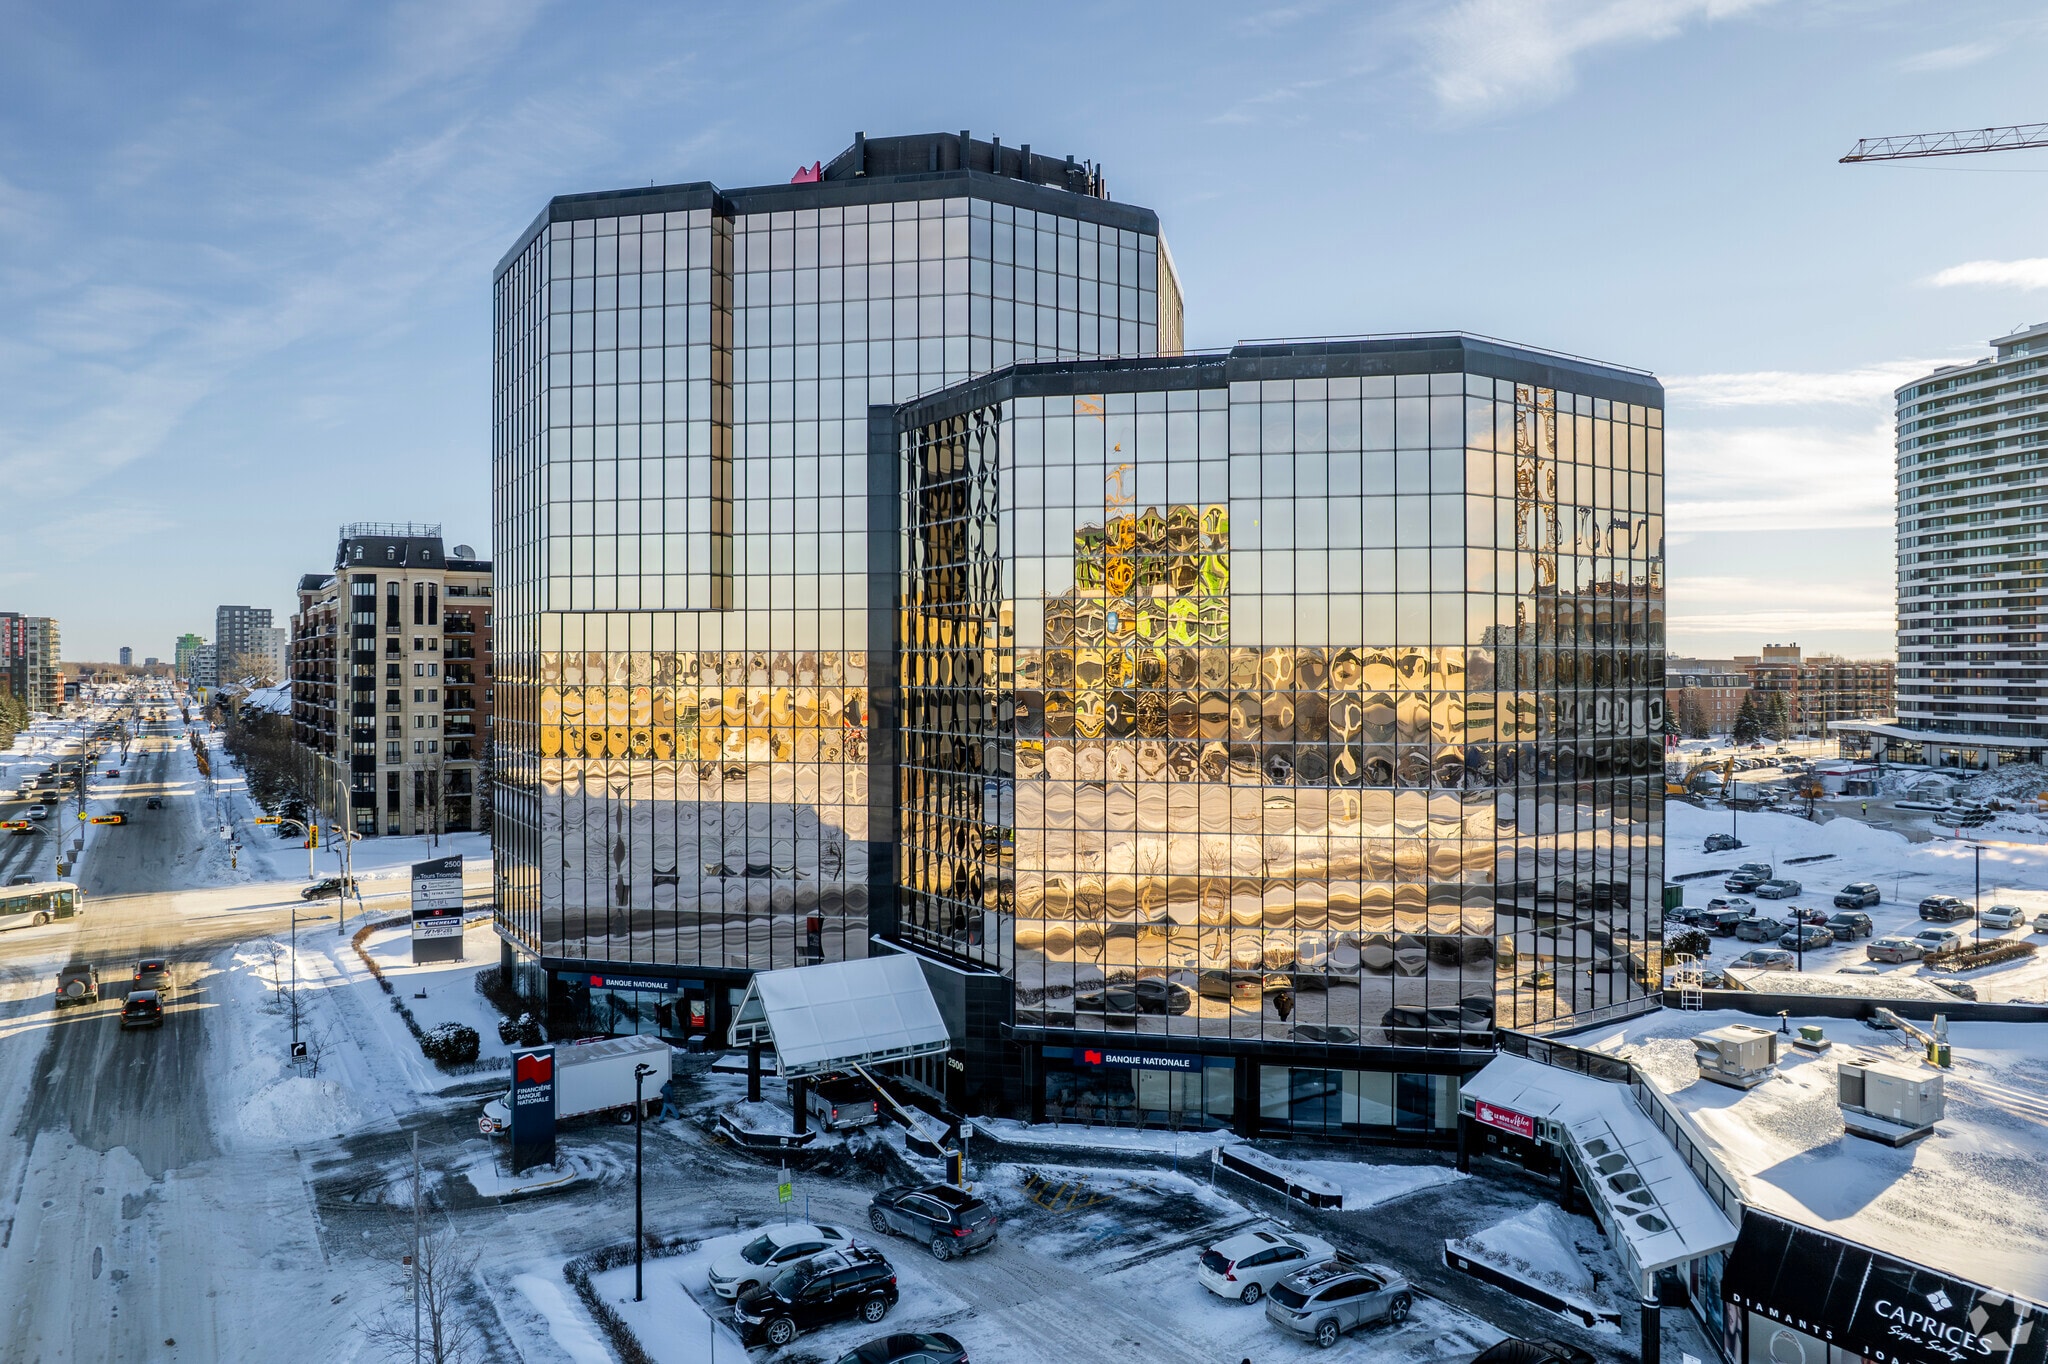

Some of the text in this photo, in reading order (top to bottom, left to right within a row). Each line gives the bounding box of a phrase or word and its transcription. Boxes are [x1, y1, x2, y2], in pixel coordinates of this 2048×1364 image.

[606, 979, 668, 989] BANQUE NATIONALE
[948, 1057, 964, 1072] 2500
[1105, 1054, 1190, 1067] BANQUE NATIONALE
[517, 1084, 551, 1094] FINANCIÈRE
[517, 1092, 541, 1100] BANQUE
[517, 1096, 549, 1106] NATIONALE
[1733, 1293, 1833, 1340] DIAMANTS
[1875, 1300, 1993, 1356] CAPRICES
